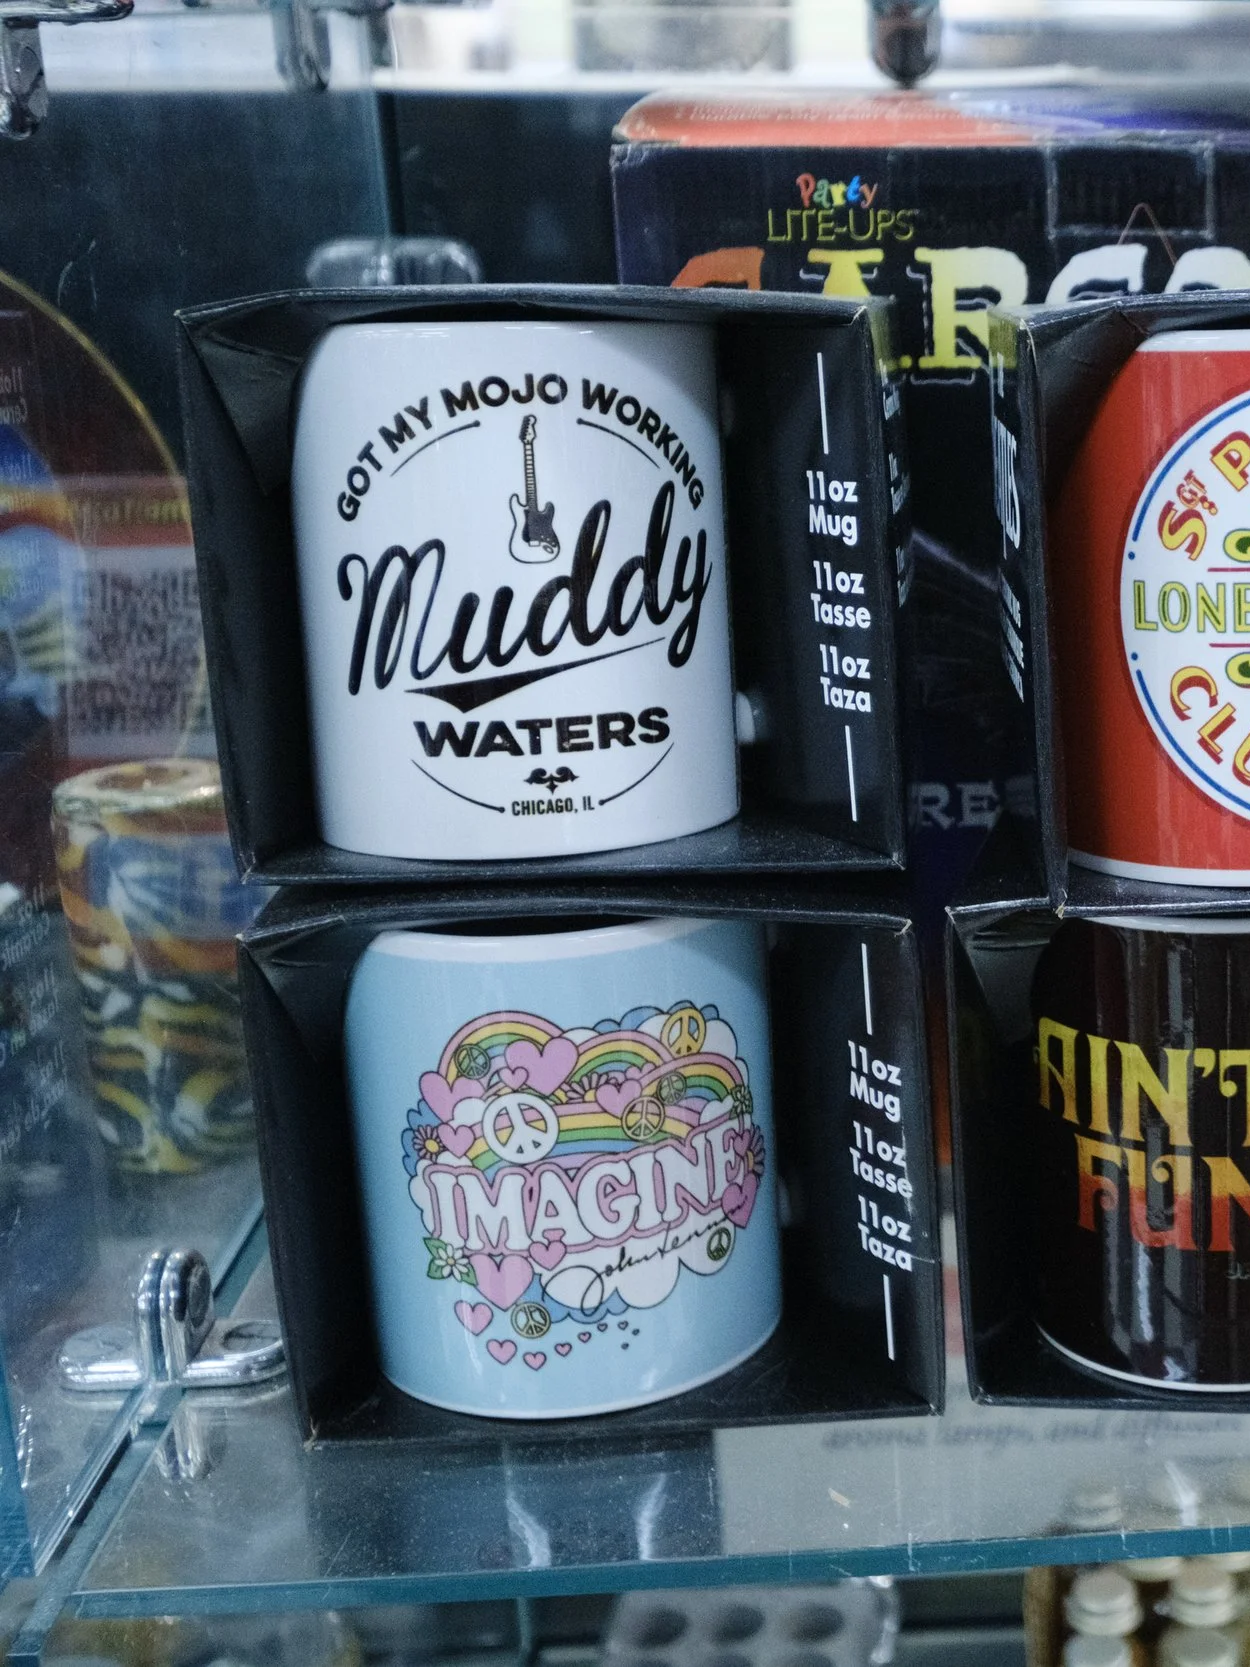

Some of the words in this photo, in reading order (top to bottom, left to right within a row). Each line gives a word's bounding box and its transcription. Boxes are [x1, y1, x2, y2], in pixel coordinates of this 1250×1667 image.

[796, 172, 879, 208] Party
[767, 207, 916, 241] LITE-UPS
[337, 441, 383, 522] GOT
[378, 396, 433, 453] MY
[440, 373, 568, 418] MOJO
[582, 378, 705, 510] WORKING
[806, 470, 858, 502] 11oz
[808, 504, 858, 546] Mug
[337, 480, 713, 696] Muddy
[813, 560, 865, 594] 11oz
[810, 593, 871, 628] Tasse
[820, 643, 870, 679] 11oz
[820, 676, 872, 712] Taza
[413, 706, 671, 758] WATERS
[511, 797, 578, 816] CHICAGO,
[582, 796, 596, 811] IL
[848, 1040, 902, 1086] 11oz
[850, 1071, 901, 1123] Mug
[853, 1120, 907, 1167] 11oz
[428, 1118, 750, 1256] IMAGINE
[849, 1146, 913, 1198] Tasse
[858, 1194, 912, 1242] 11oz
[858, 1222, 913, 1273] Taza
